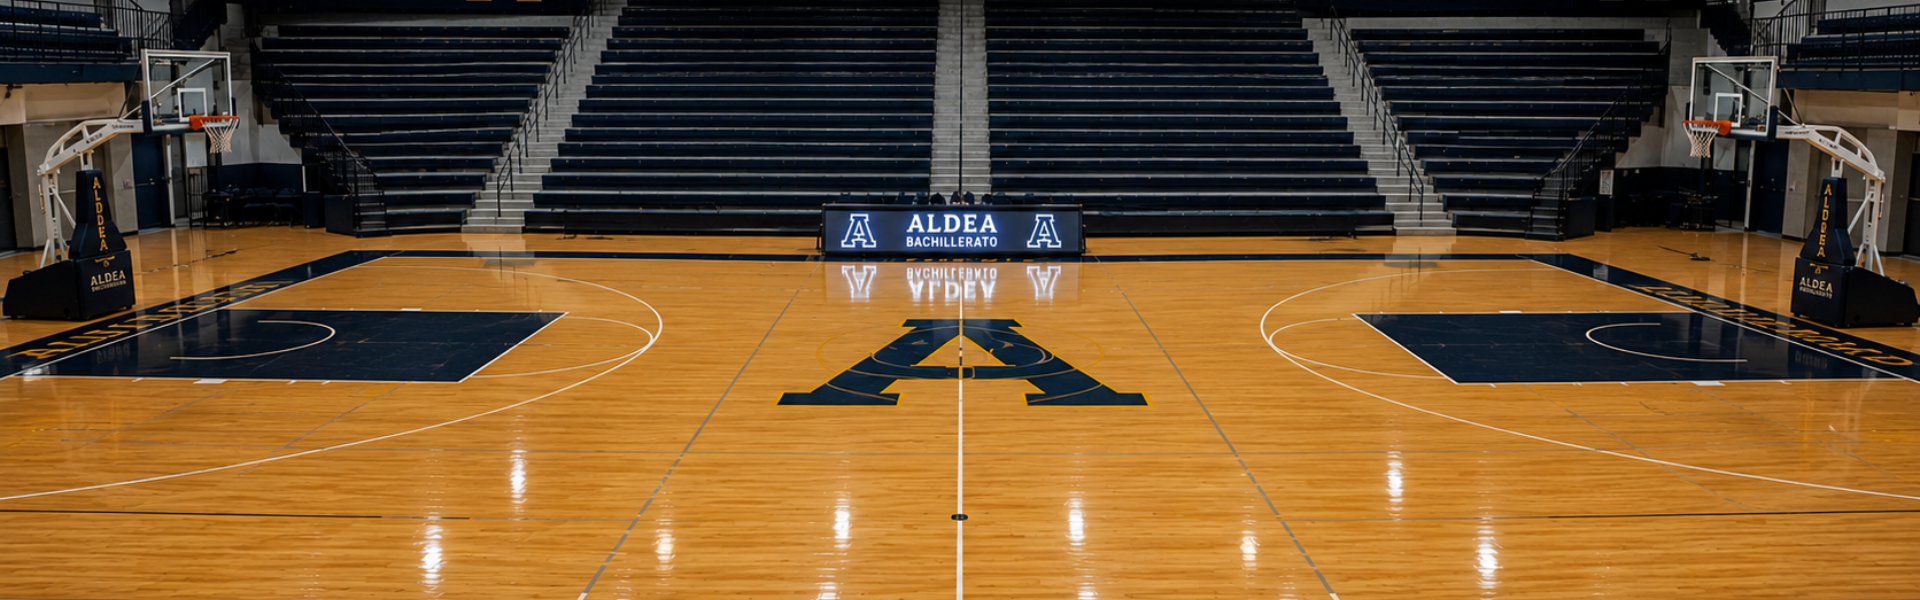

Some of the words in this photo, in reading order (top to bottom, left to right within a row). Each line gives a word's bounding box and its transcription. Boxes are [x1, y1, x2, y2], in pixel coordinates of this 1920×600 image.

[841, 213, 877, 248] A
[906, 213, 998, 234] ALDEA
[1026, 213, 1062, 248] A
[906, 236, 998, 248] BACHILLERATO
[90, 270, 126, 287] ALDEA
[1799, 276, 1833, 293] ALDEA
[776, 318, 1151, 406] A
